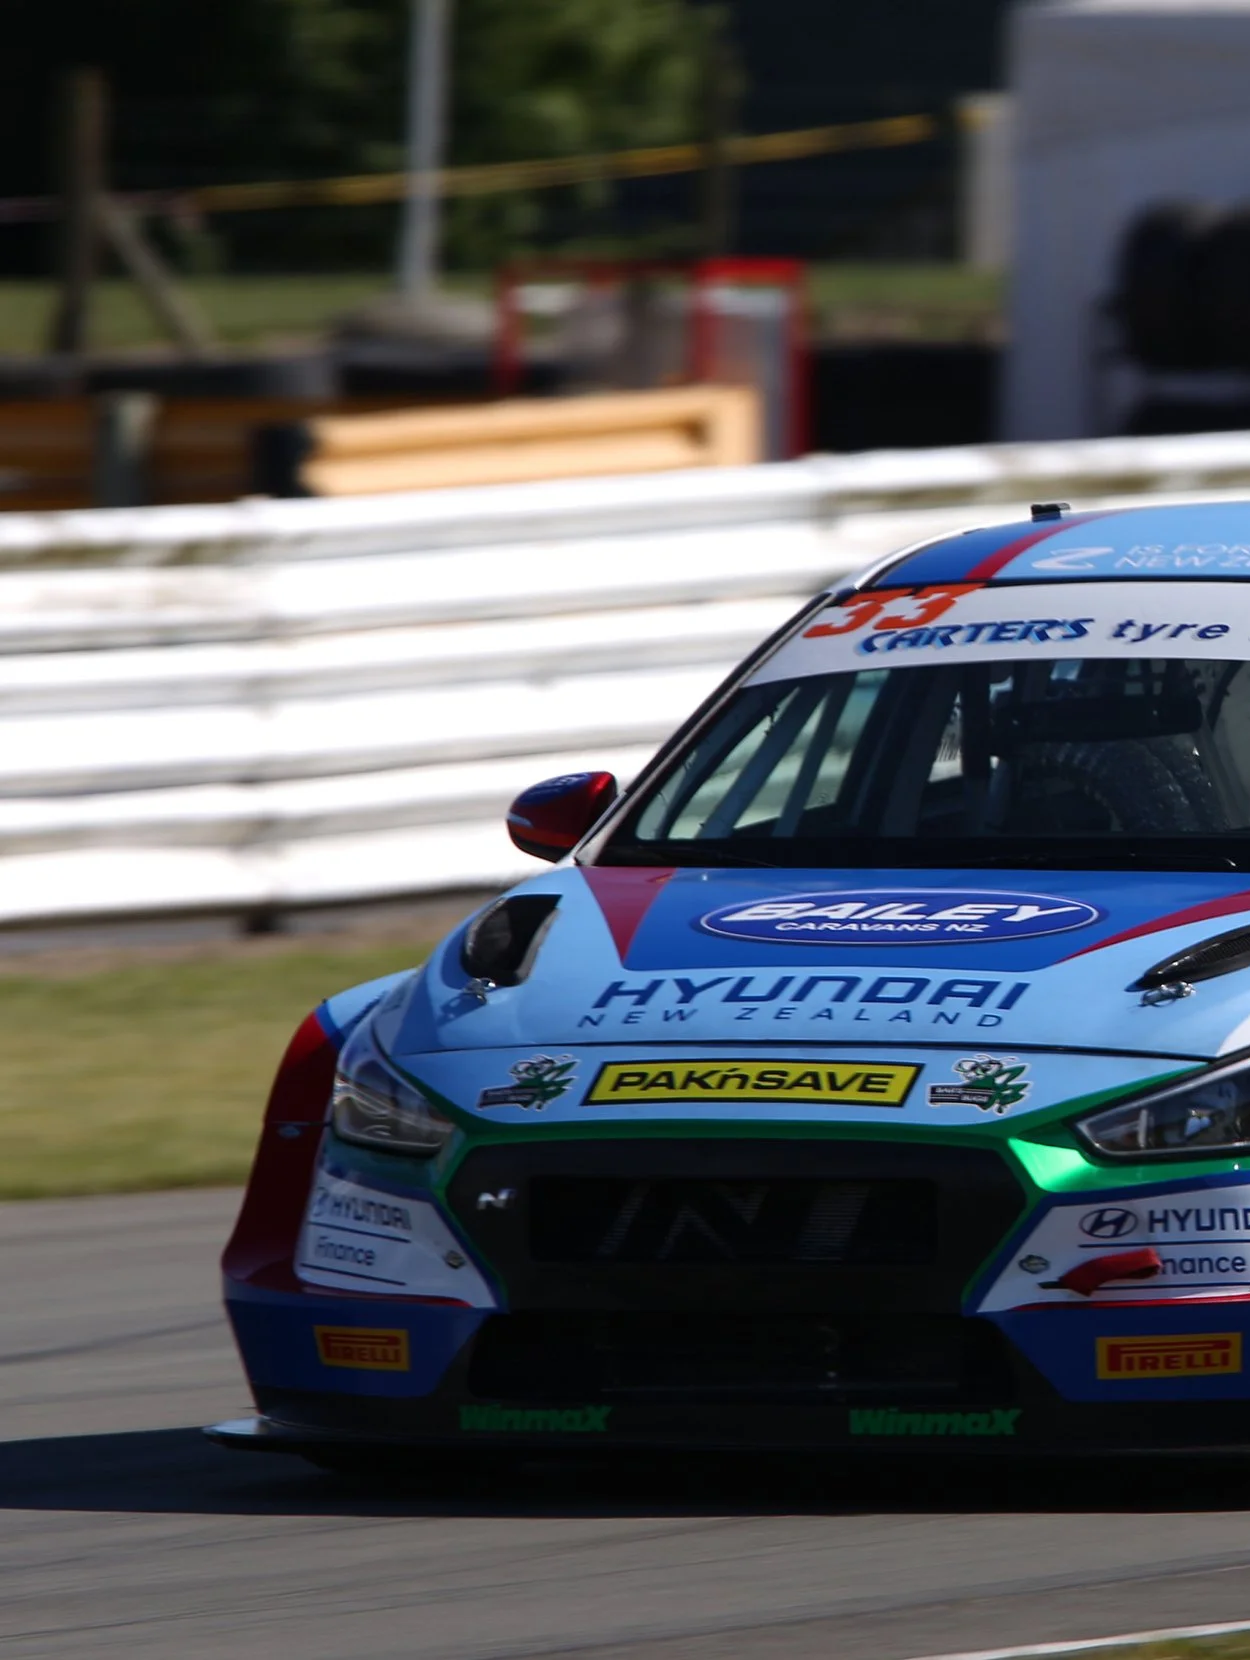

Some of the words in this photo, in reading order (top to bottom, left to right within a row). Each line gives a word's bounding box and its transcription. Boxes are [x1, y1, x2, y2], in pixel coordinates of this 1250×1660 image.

[1114, 555, 1212, 569] NEW
[1127, 543, 1164, 555] IS
[802, 582, 986, 638] 33
[856, 617, 1095, 655] CARTER'S
[1110, 619, 1230, 642] tyre
[720, 901, 1082, 922] BAILEY
[774, 921, 938, 933] CARAVANS
[945, 922, 991, 933] NZ
[592, 975, 1031, 1011] HYUNDAI
[577, 1007, 699, 1028] NEW
[735, 1006, 1004, 1028] ZEALAND
[331, 1193, 412, 1231] HYUNDAI
[315, 1236, 375, 1266] Finance
[321, 1332, 401, 1363] PIRELLI
[1107, 1340, 1232, 1371] PIRELLI
